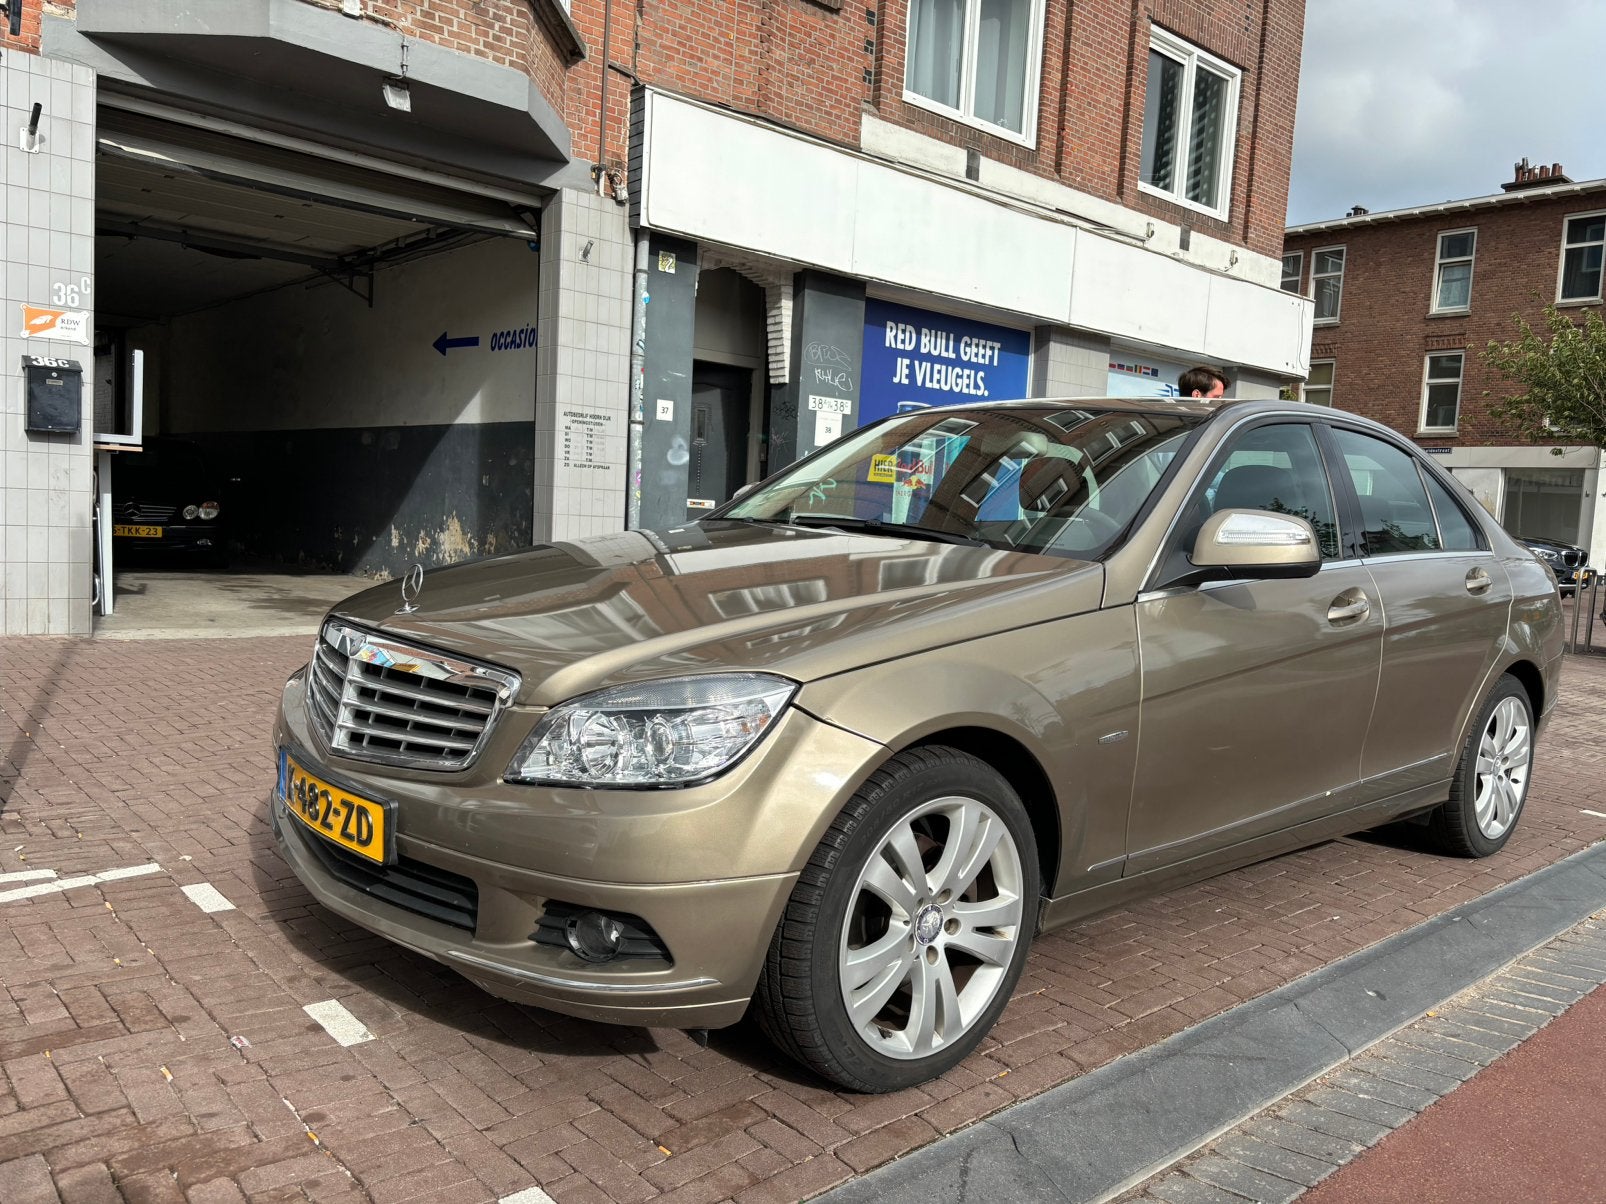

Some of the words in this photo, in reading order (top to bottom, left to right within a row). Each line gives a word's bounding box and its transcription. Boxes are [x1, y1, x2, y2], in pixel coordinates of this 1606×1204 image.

[885, 320, 916, 350] RED
[920, 328, 956, 359] BULL
[960, 336, 1001, 366] GEEFT
[892, 358, 910, 384] JE
[914, 360, 988, 396] VLEUGELS.
[874, 460, 893, 472] HIER
[286, 763, 374, 848] K-482-ZD
